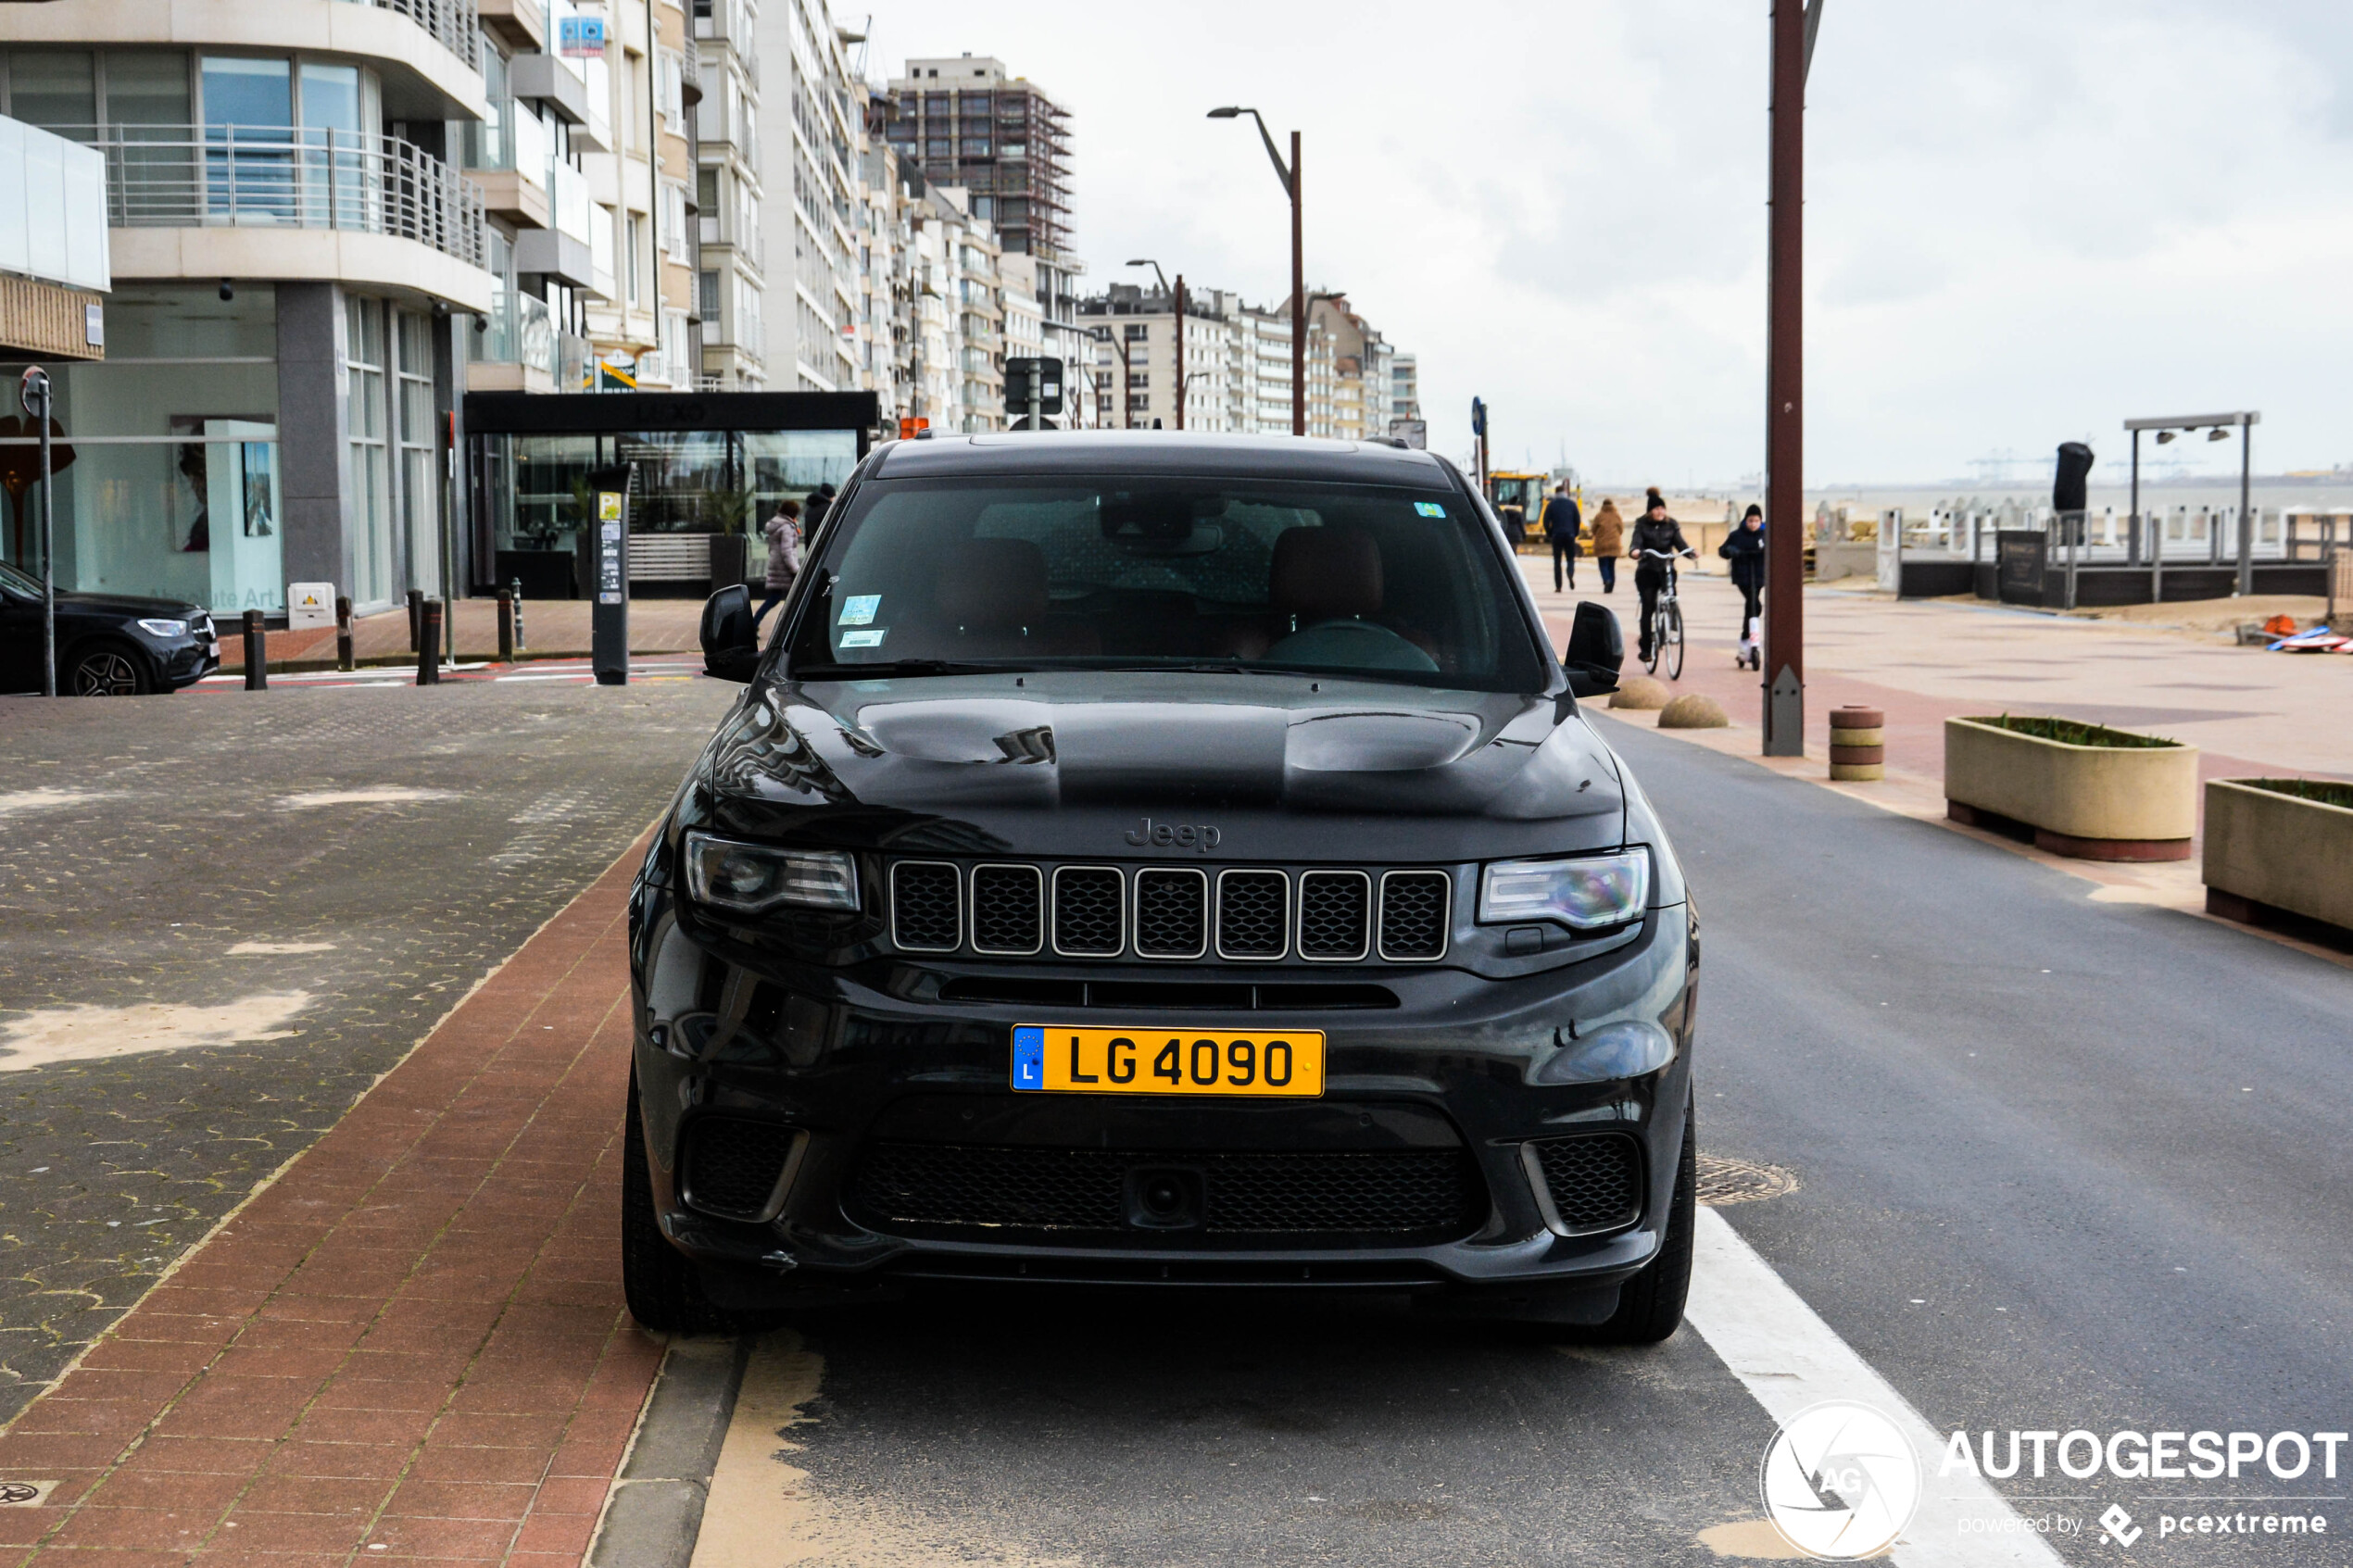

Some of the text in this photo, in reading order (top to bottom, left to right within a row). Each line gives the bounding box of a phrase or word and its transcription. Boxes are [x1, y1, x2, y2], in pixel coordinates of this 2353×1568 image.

[601, 494, 613, 516] P
[244, 587, 275, 608] Art
[1125, 818, 1220, 852] Jeep
[1023, 1063, 1033, 1080] L
[1070, 1036, 1292, 1086] LG 4090
